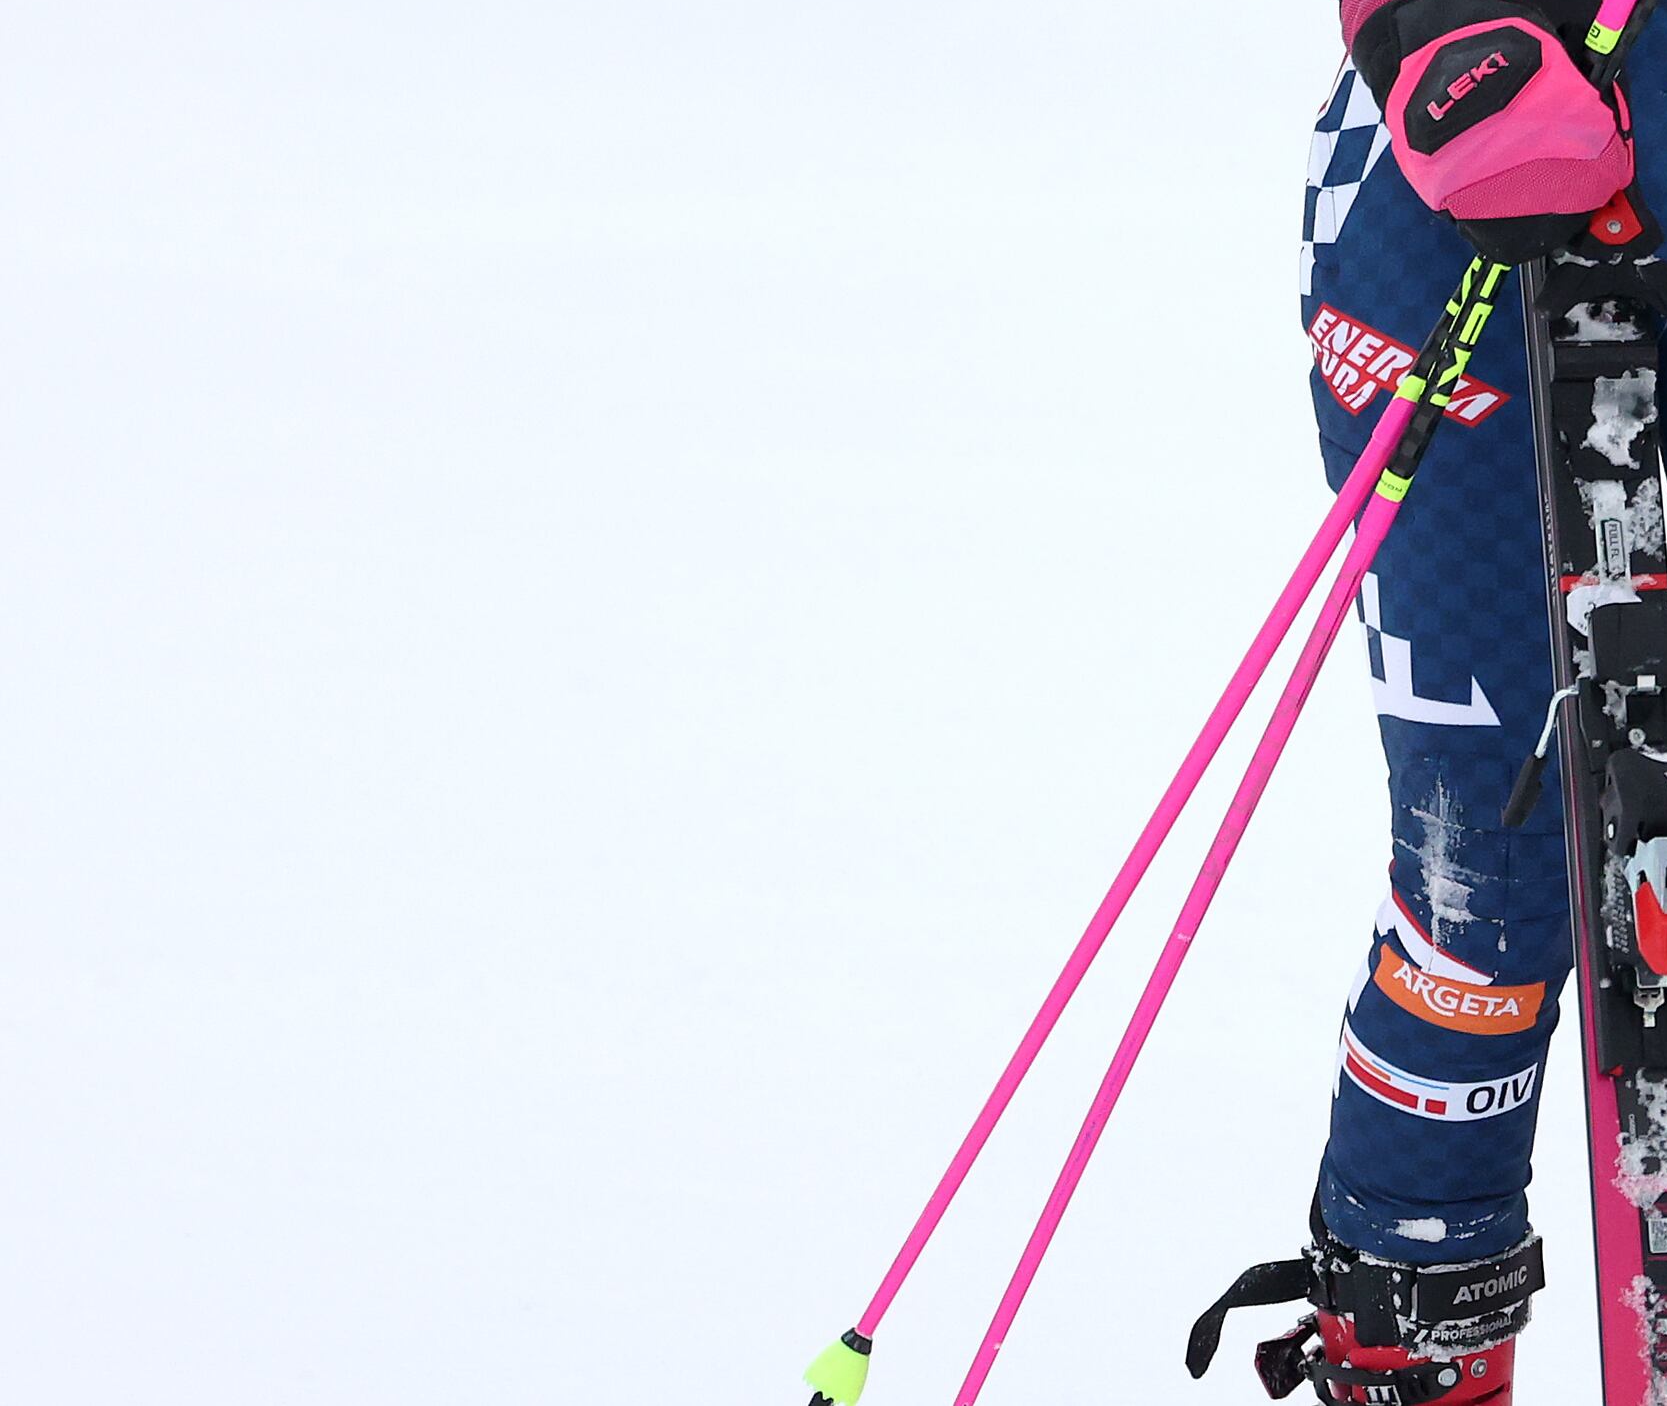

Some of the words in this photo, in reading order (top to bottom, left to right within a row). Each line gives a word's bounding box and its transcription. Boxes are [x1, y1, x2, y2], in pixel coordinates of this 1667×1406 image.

[1426, 50, 1510, 122] LEKI
[1393, 961, 1521, 1018] ARGETA
[1452, 1267, 1528, 1305] ATOMIC
